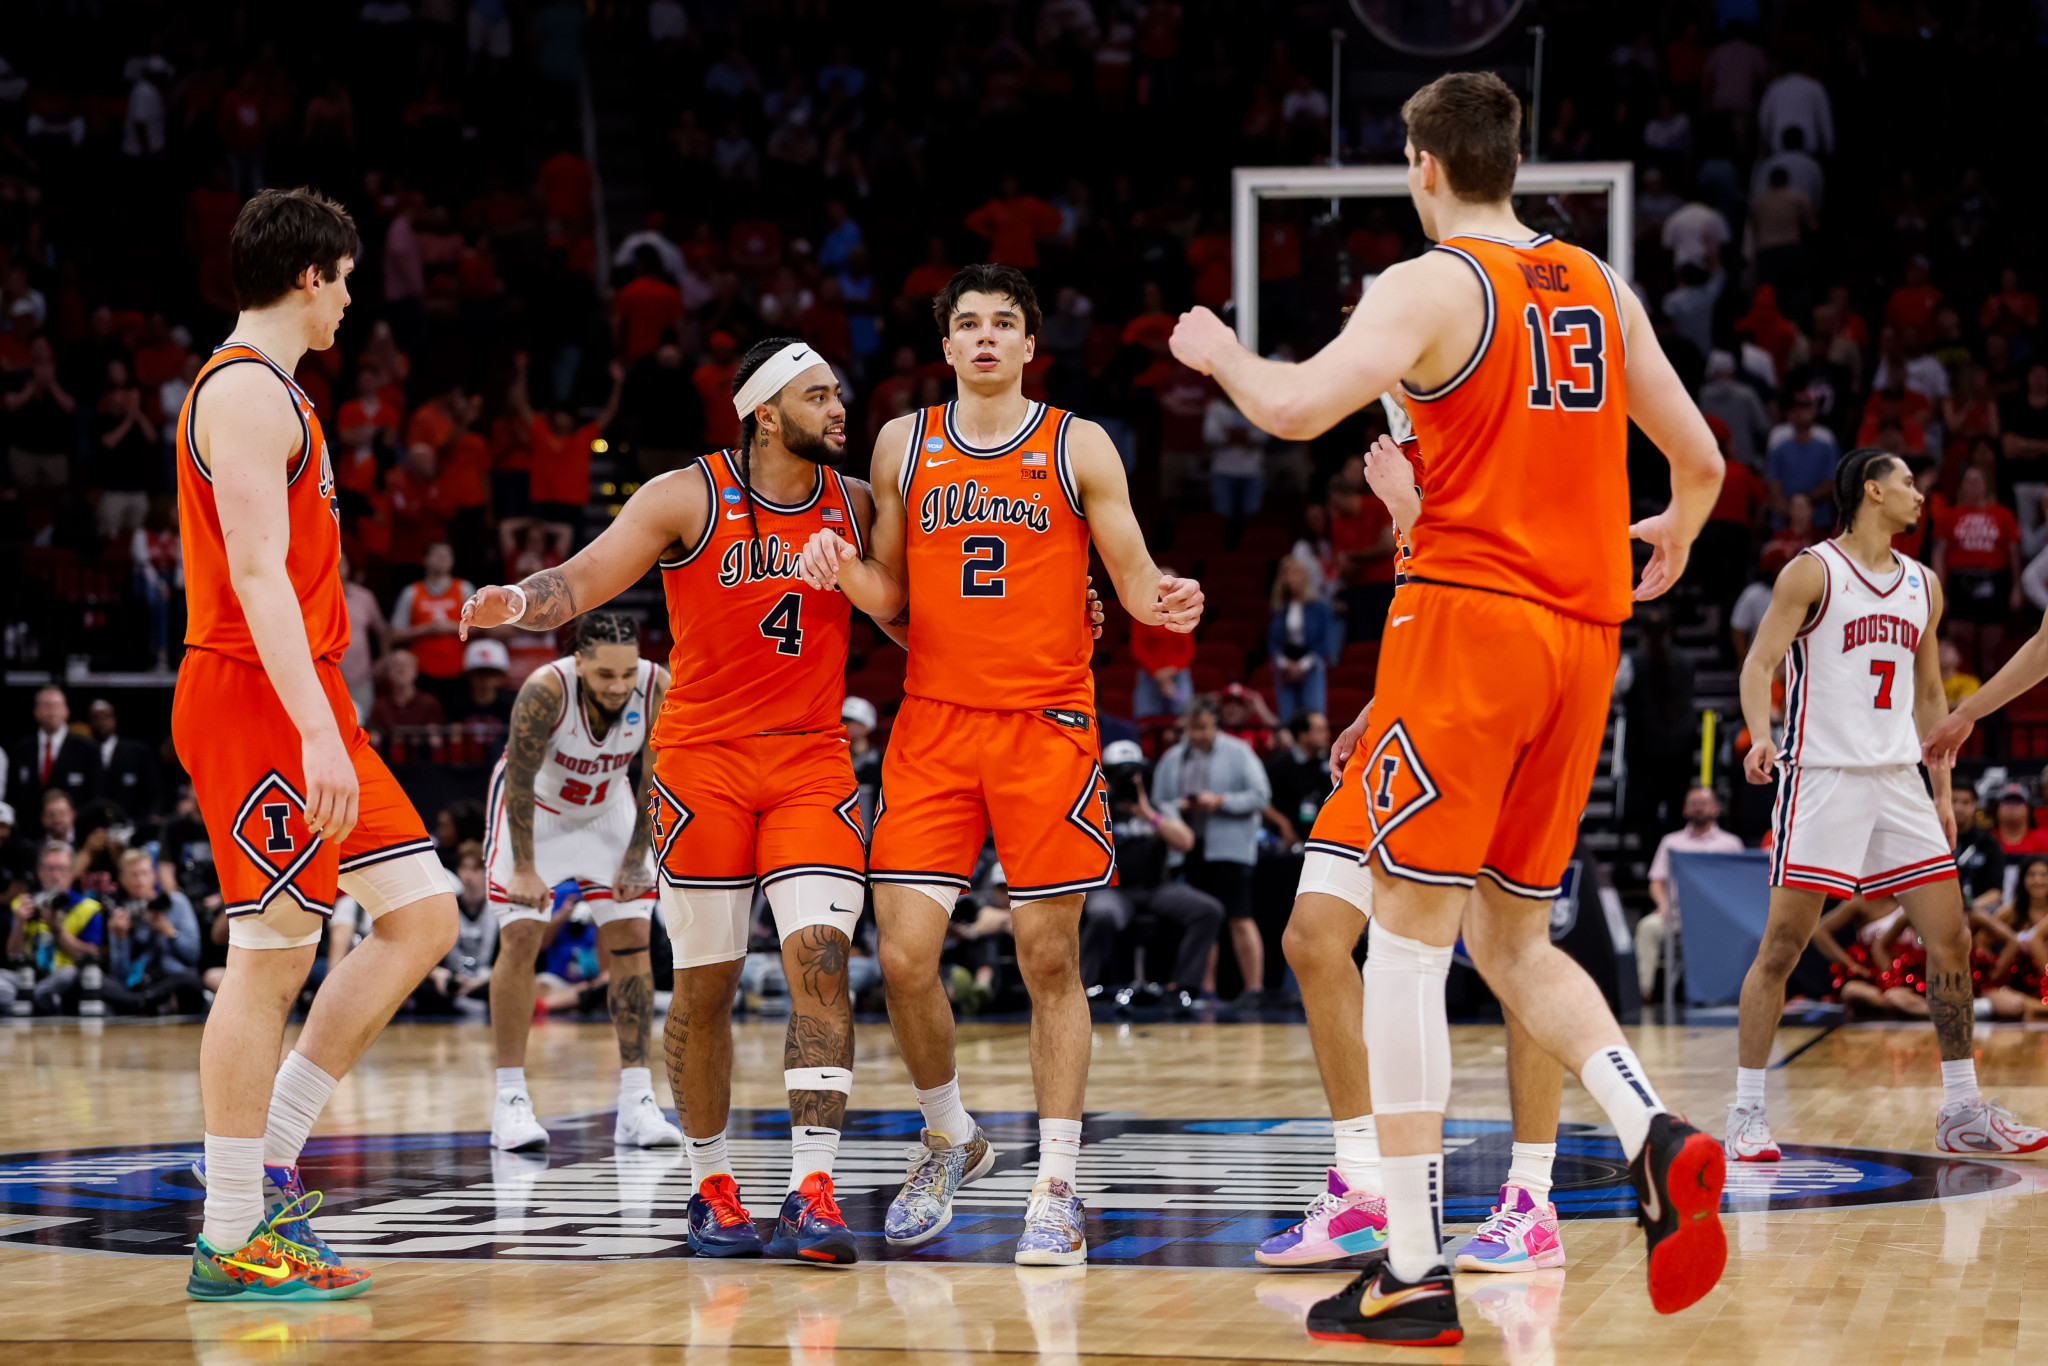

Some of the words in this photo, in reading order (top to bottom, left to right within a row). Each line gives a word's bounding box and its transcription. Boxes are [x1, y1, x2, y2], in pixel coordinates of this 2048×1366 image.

[1523, 302, 1607, 412] 13
[919, 479, 1051, 534] Illinois
[718, 534, 840, 592] Illin
[961, 535, 1007, 598] 2
[759, 592, 803, 657] 4
[1842, 613, 1920, 655] HOUSTON
[1870, 659, 1896, 710] 7
[554, 750, 634, 776] HOUSTON
[559, 778, 611, 806] 21
[262, 802, 295, 854] I
